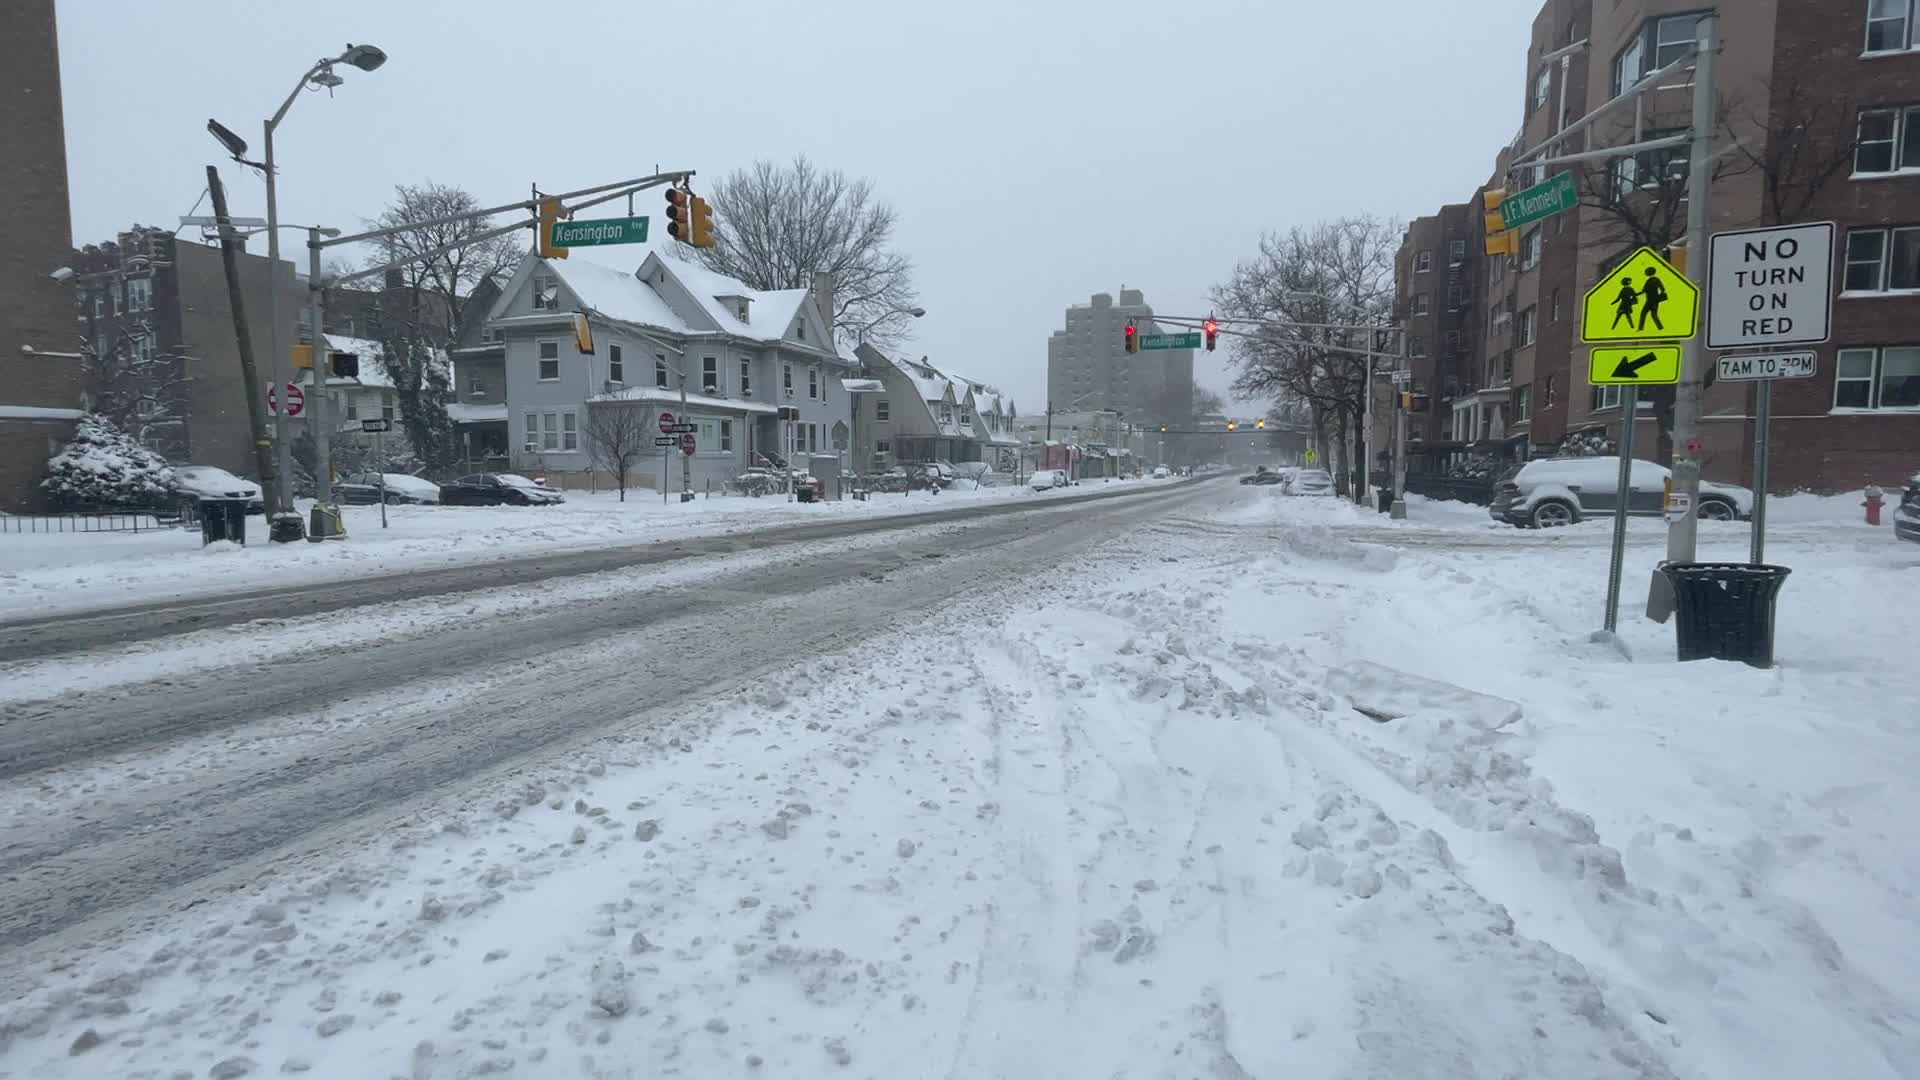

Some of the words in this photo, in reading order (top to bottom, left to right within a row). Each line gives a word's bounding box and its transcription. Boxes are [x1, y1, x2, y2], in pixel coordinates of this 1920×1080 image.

[1519, 186, 1564, 216] Kennedy
[555, 223, 623, 244] Kensington
[1744, 238, 1798, 262] NO
[1734, 266, 1804, 288] TURN
[1749, 292, 1787, 311] ON
[1742, 317, 1793, 336] RED
[1721, 360, 1752, 375] 7AM
[1758, 359, 1776, 373] TO
